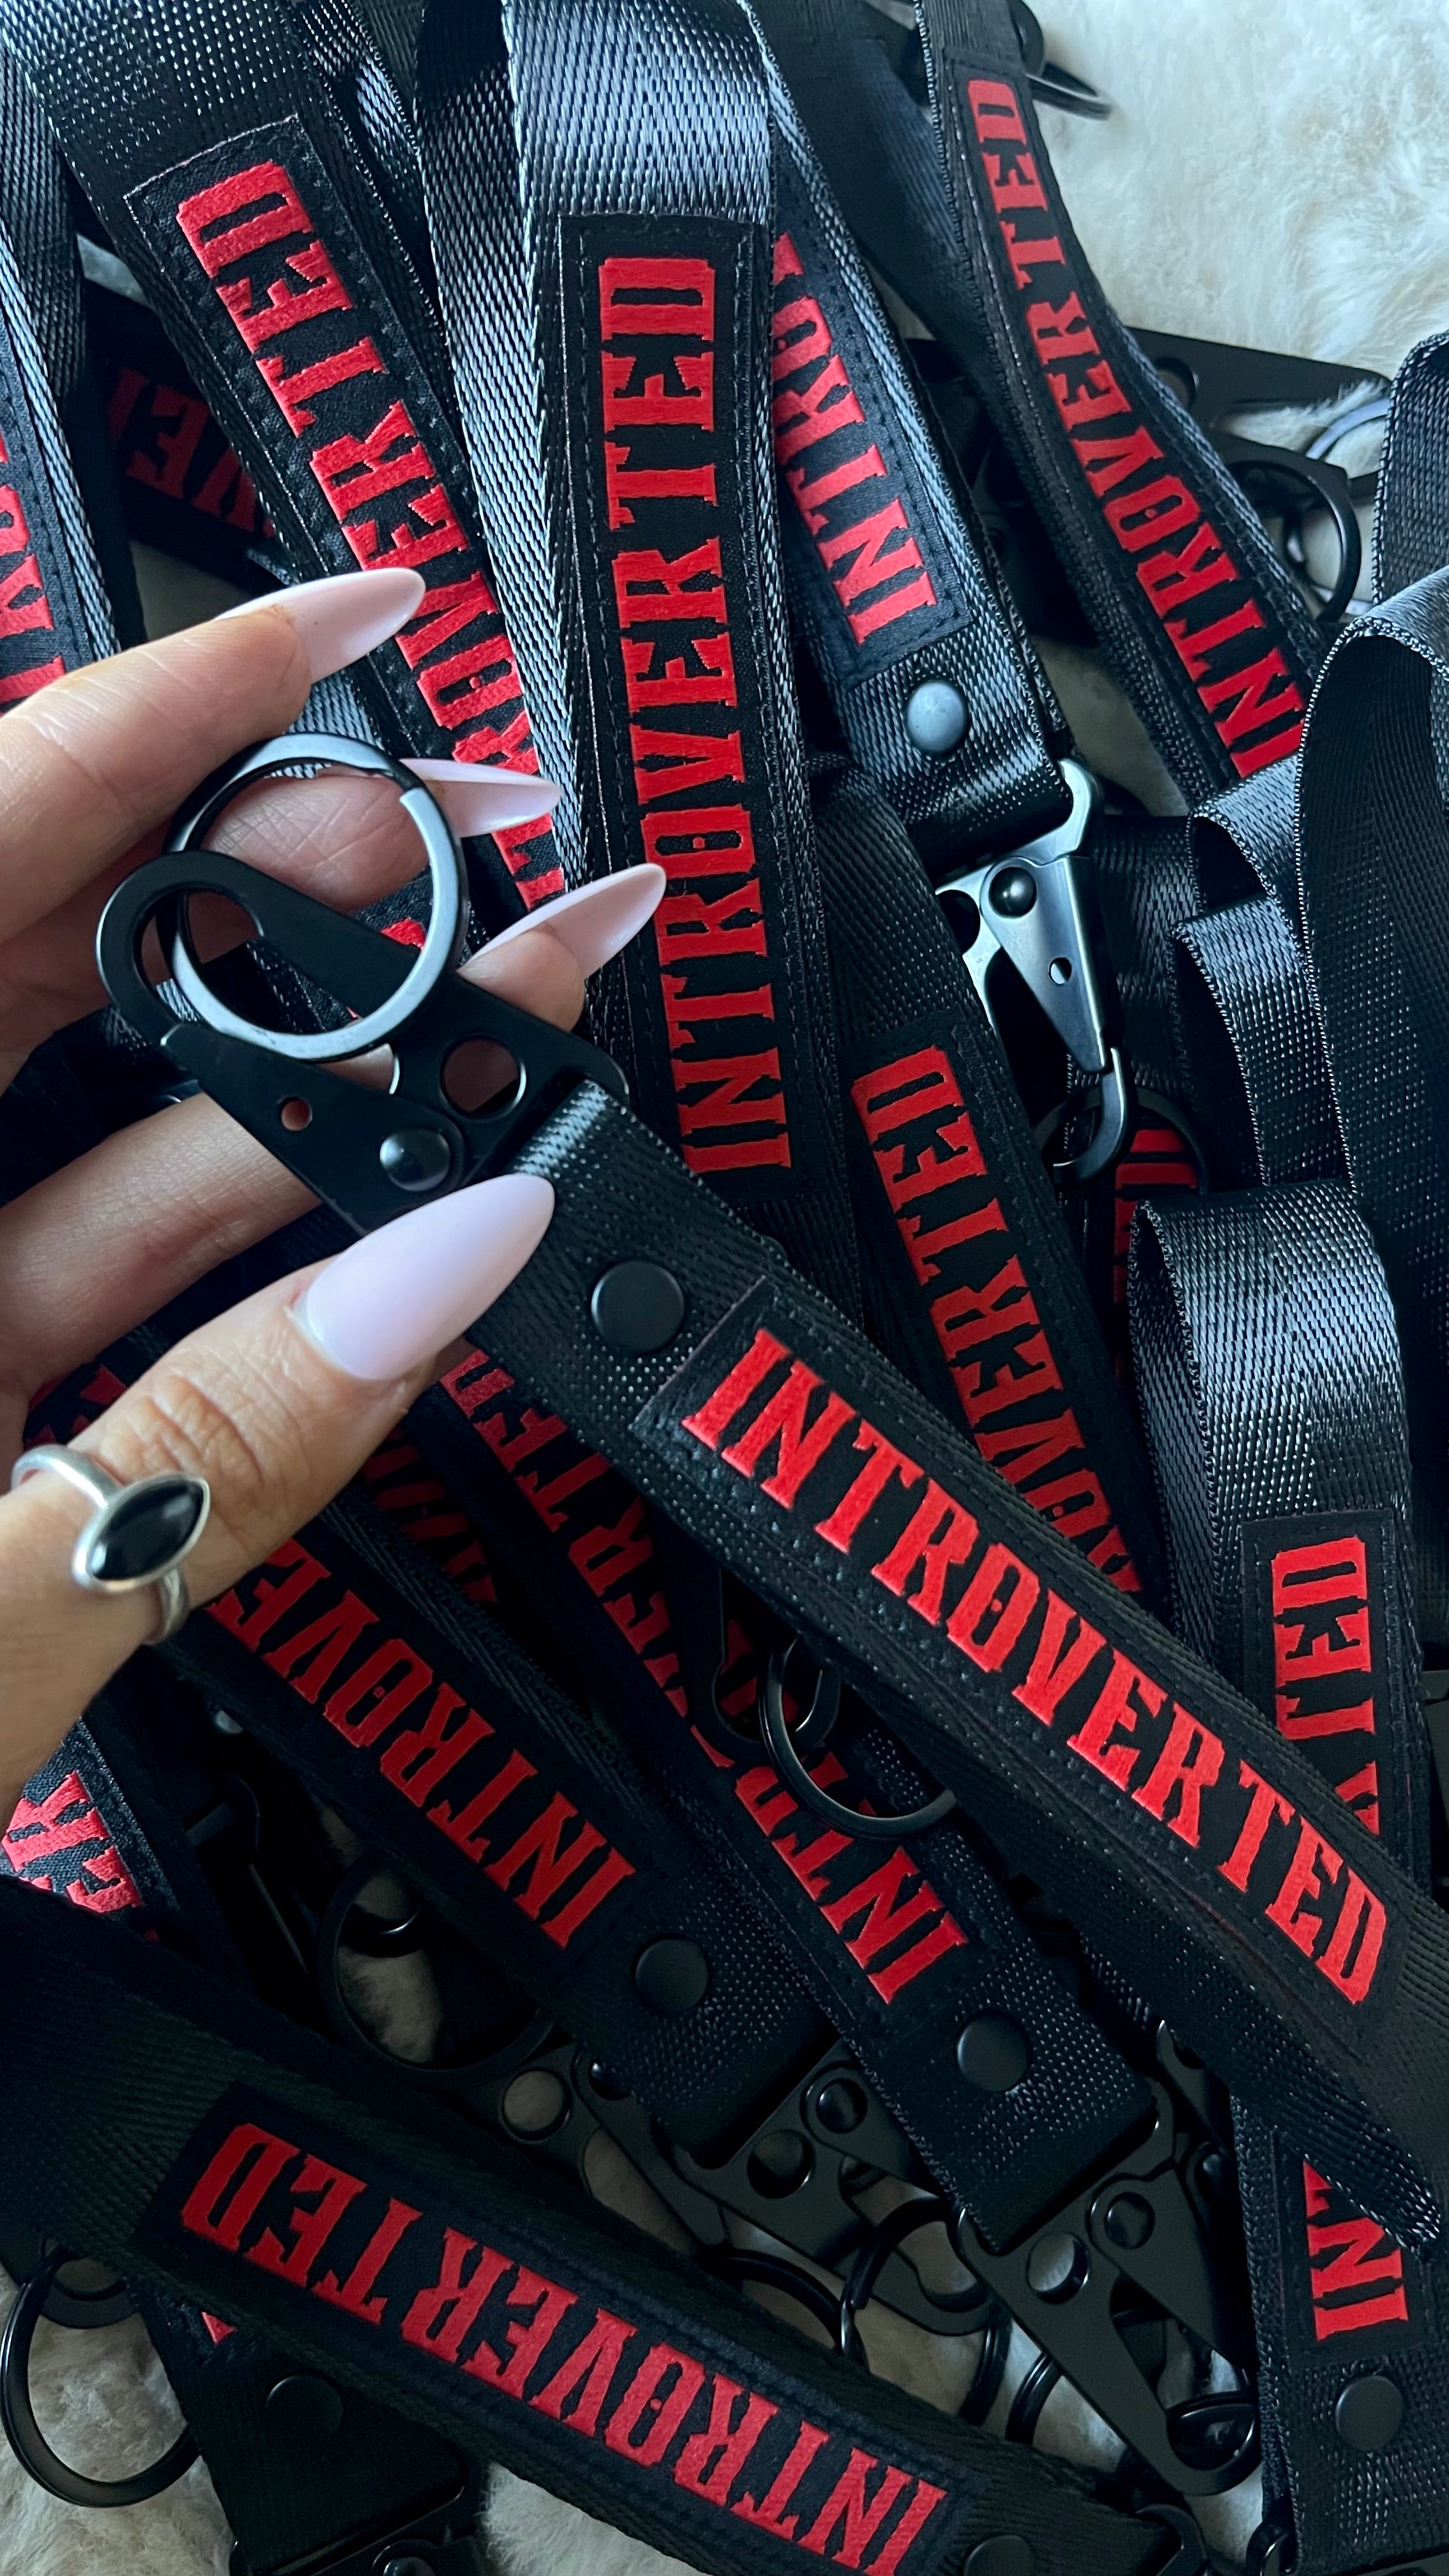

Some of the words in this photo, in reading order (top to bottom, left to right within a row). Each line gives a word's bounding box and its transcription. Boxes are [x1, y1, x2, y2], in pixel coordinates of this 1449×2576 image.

[176, 160, 565, 910] ROVERTED
[599, 257, 793, 1173] INTROVERTED
[967, 79, 1305, 778] INTROVERTED
[850, 1045, 1142, 1592] OVERTED
[206, 1537, 636, 1949] INTROVE
[684, 1329, 1390, 2005] INTROVERTED
[180, 2122, 948, 2576] INTROVERTED
